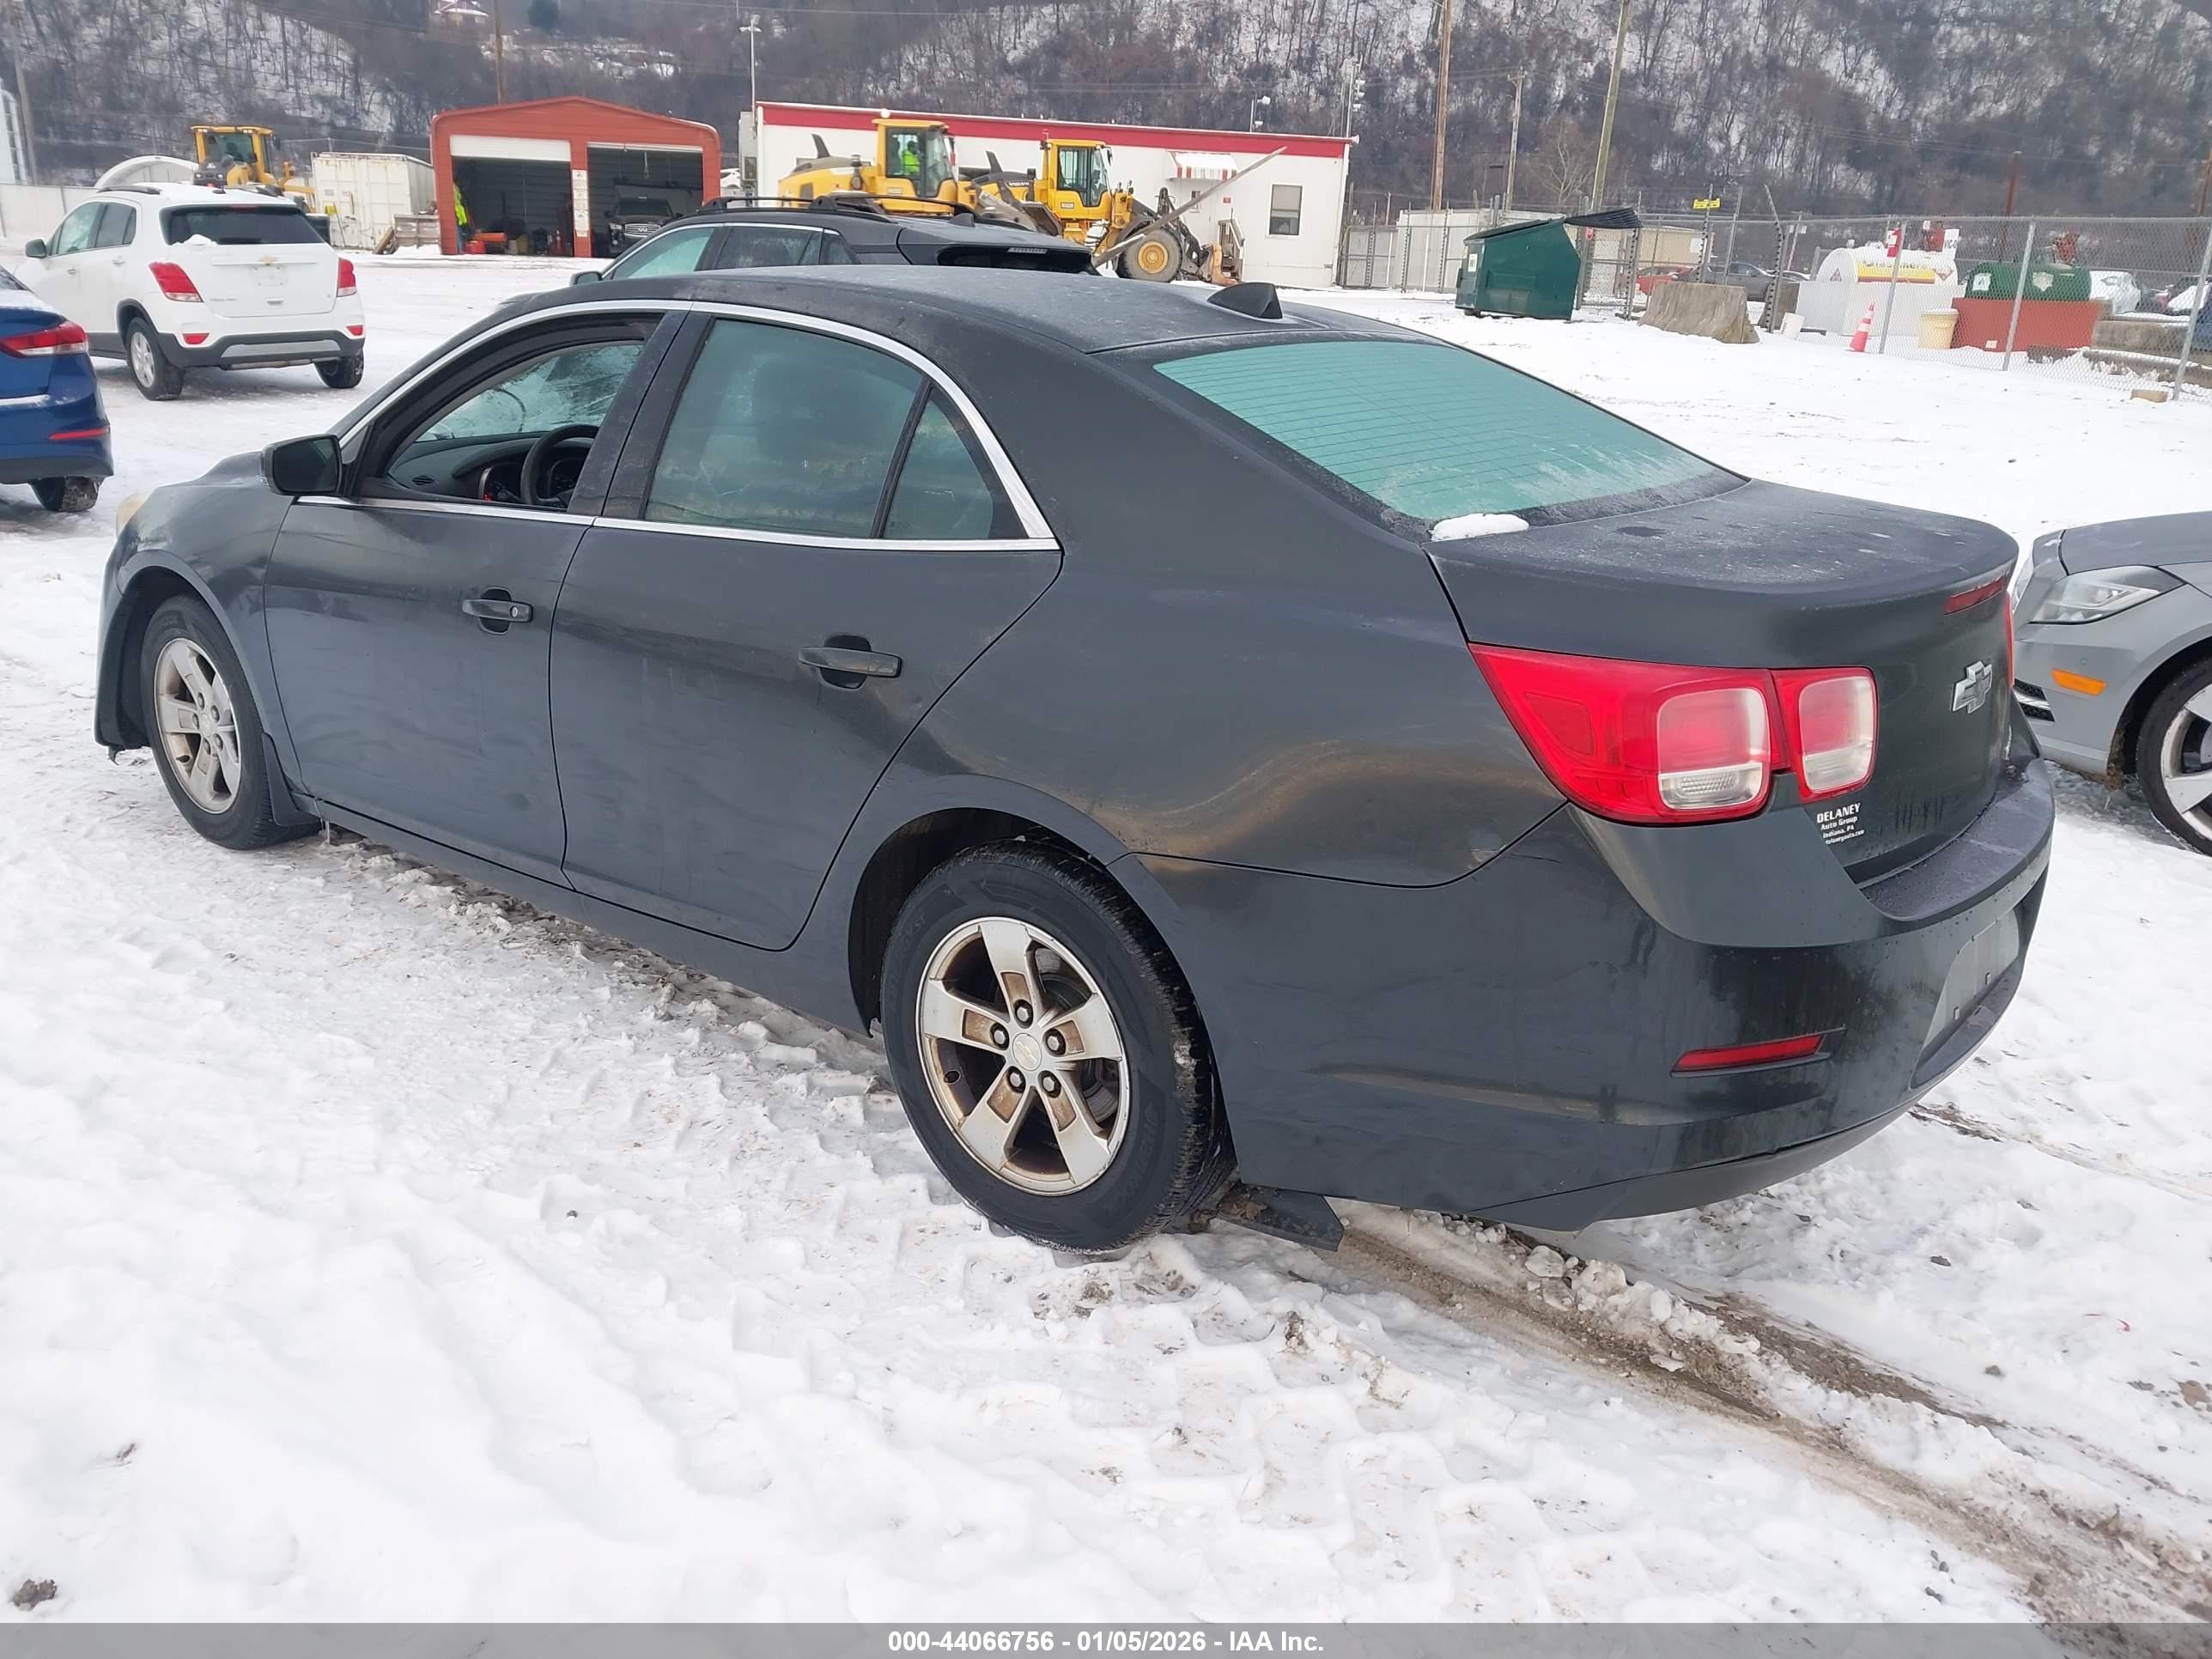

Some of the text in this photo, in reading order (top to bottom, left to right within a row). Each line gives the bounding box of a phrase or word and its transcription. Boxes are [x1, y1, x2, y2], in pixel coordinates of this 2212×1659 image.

[1816, 802, 1861, 823] DELANEY
[1820, 816, 1858, 831] Auto Group
